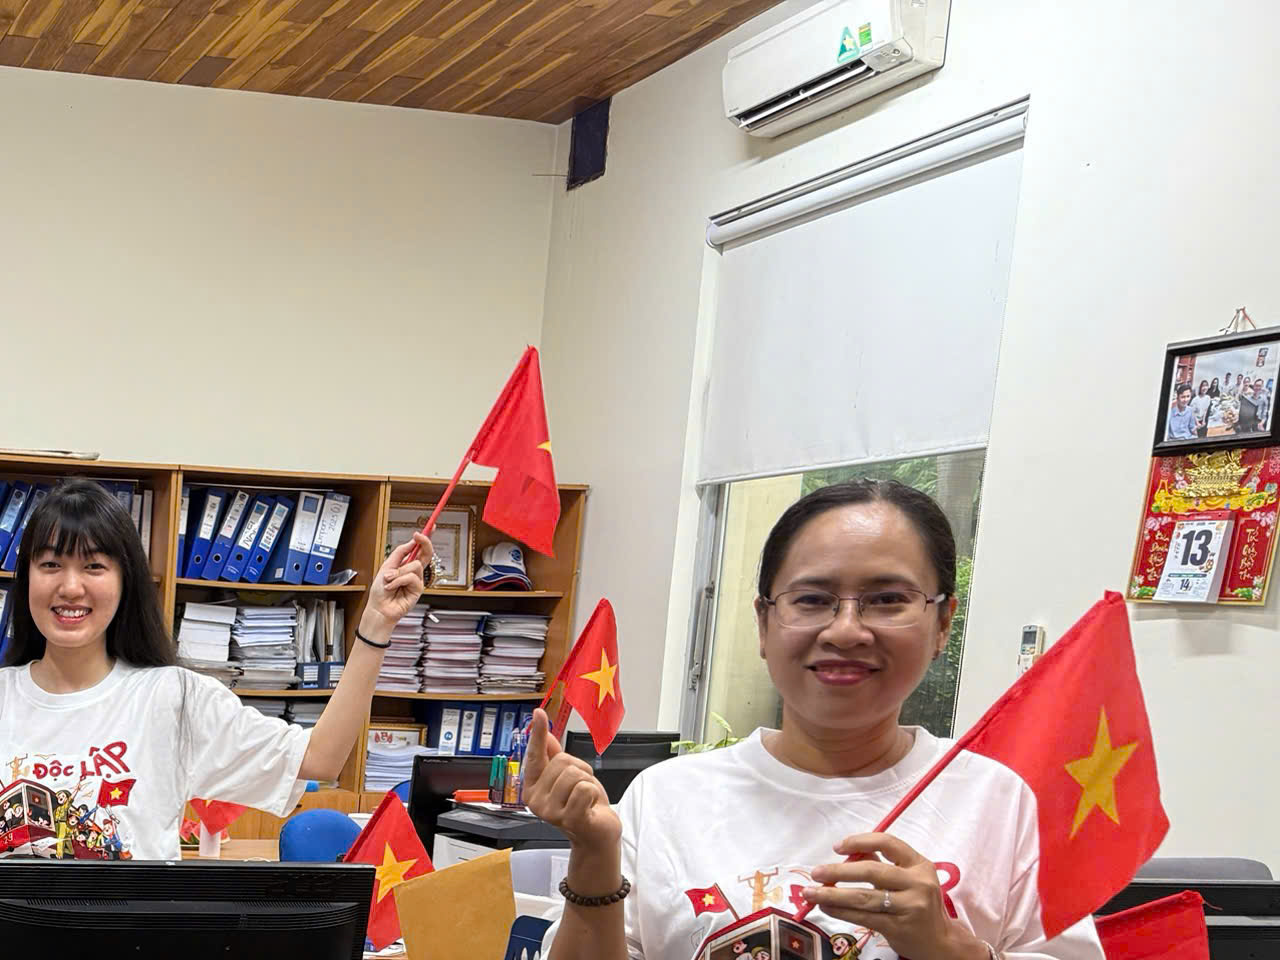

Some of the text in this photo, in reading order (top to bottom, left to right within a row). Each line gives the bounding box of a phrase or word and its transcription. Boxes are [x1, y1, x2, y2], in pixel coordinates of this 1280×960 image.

[1181, 529, 1212, 566] 13
[1180, 579, 1191, 590] 14
[33, 741, 131, 781] ĐỘC LẬP
